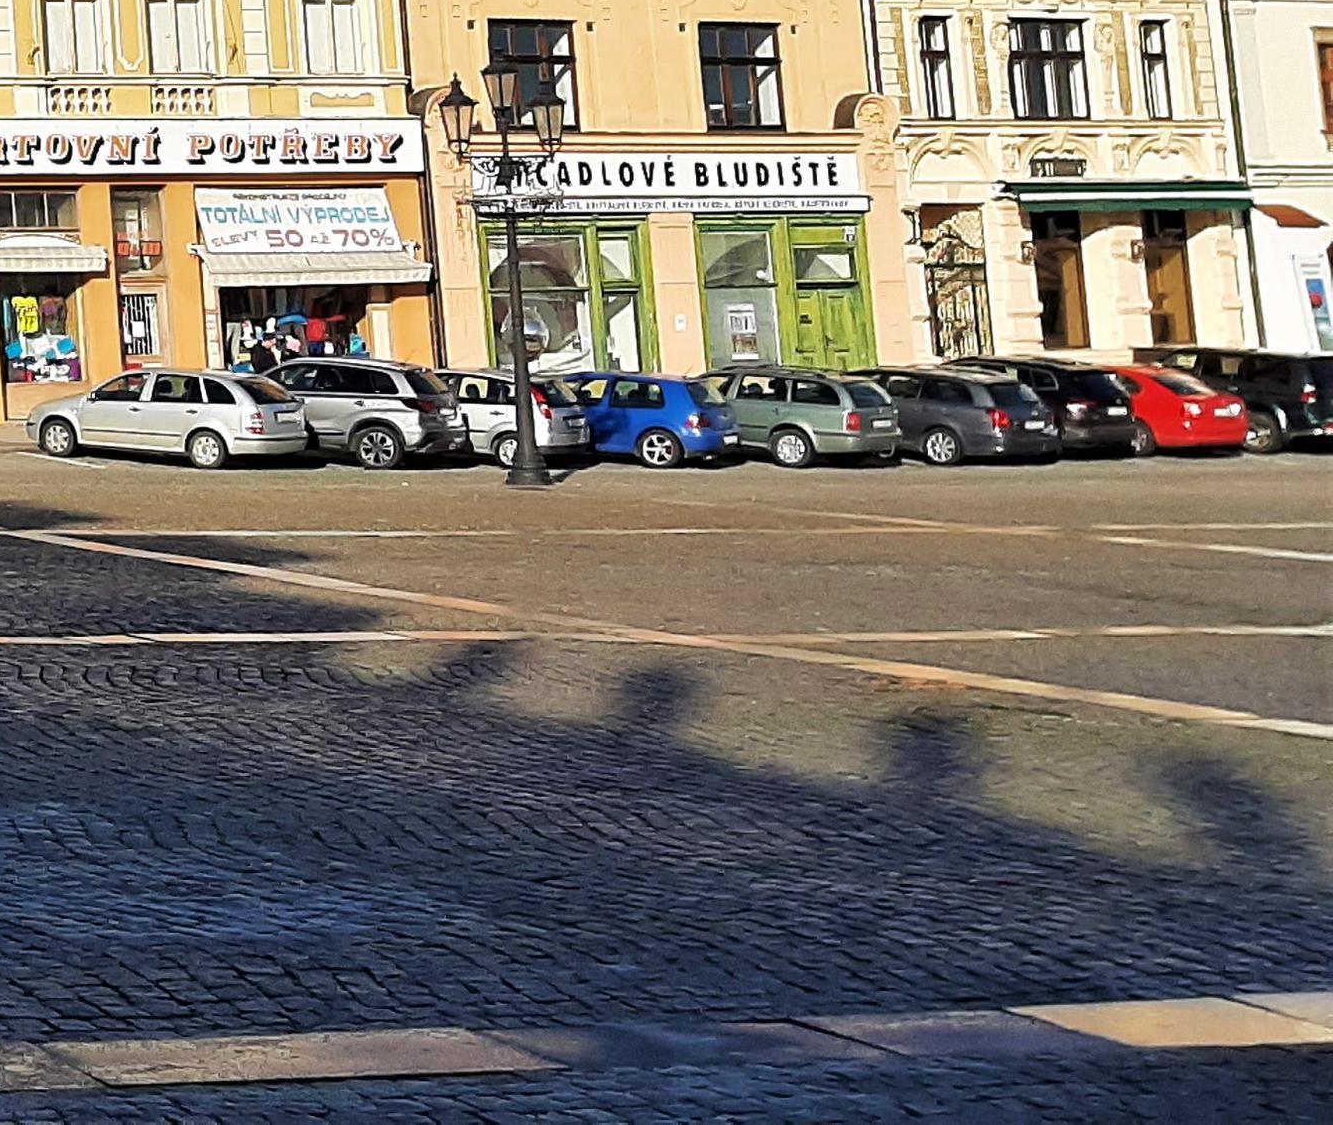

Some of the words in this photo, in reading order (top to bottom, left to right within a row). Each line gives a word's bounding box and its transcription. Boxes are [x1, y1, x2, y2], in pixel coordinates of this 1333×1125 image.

[186, 128, 404, 165] POTŘEBY
[496, 155, 676, 187] CADLOVÉ
[694, 156, 839, 187] BLUDIŠTĚ
[200, 203, 282, 225] TOTÁLNÍ
[287, 204, 391, 225] VÝPRODEJ
[211, 230, 258, 248] SLEVY
[265, 229, 303, 247] 50
[333, 228, 395, 247] 70%
